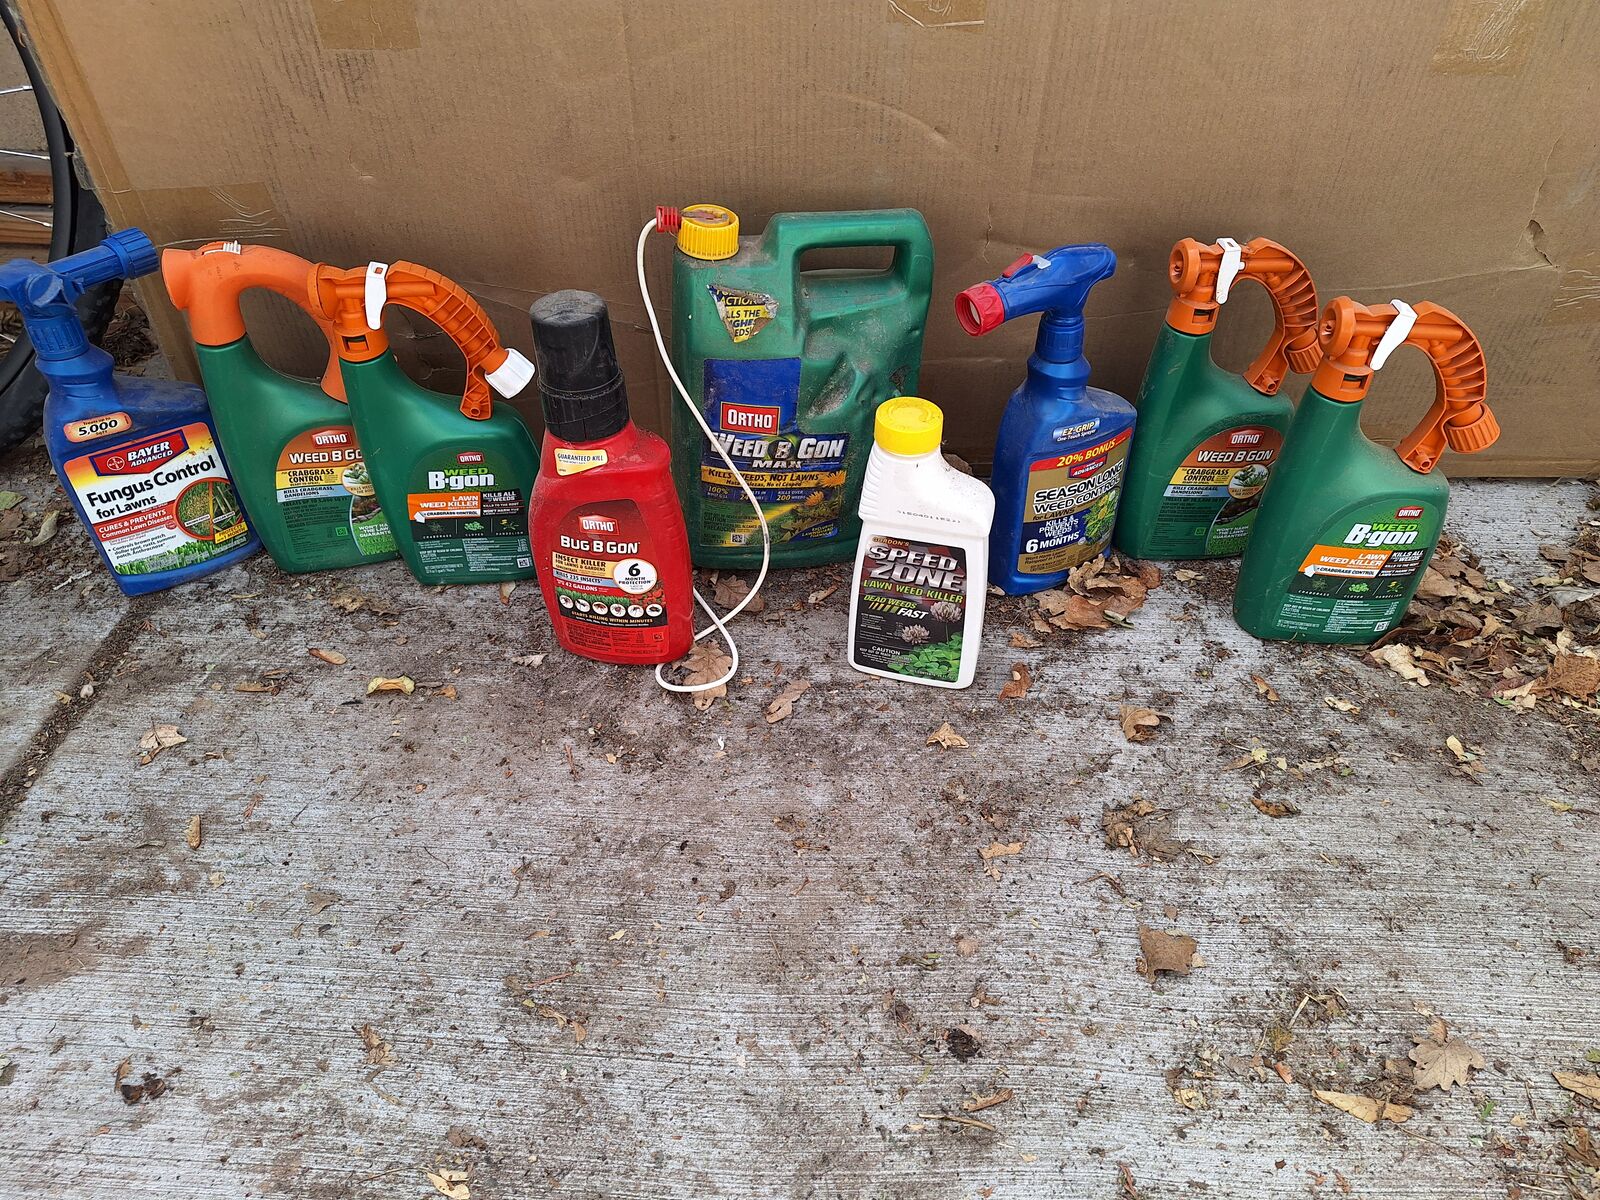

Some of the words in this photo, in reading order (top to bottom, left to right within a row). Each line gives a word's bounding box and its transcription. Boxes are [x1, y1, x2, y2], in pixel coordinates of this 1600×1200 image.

[744, 309, 760, 318] THE
[728, 409, 772, 429] ORTHO
[79, 420, 118, 436] 5,000
[315, 434, 346, 445] ORTHO
[711, 432, 768, 458] WEED
[775, 442, 792, 459] B
[798, 438, 845, 459] GON
[1231, 434, 1260, 444] ORTHO
[128, 442, 170, 462] BAYER
[289, 452, 329, 464] WEED
[332, 450, 342, 461] B
[558, 453, 591, 461] GUARANTEED
[1057, 454, 1084, 467] 20%
[1085, 439, 1116, 460] BONUS
[1198, 450, 1233, 462] WEED
[1235, 451, 1246, 462] B
[1247, 450, 1273, 461] GON
[130, 450, 173, 468] ADVANCED
[752, 460, 802, 469] MAX
[288, 468, 334, 477] CRABGRASS
[444, 468, 488, 476] WEED
[708, 468, 733, 480] KILLS
[770, 474, 787, 482] NOT
[86, 478, 154, 507] Fungus
[154, 455, 216, 487] Control
[289, 475, 323, 484] CONTROL
[1034, 479, 1097, 503] SEASON
[1097, 460, 1124, 486] LONG
[708, 485, 728, 495] 100%
[1033, 498, 1075, 514] WEED
[1075, 478, 1120, 504] CONTROL
[96, 508, 115, 519] for
[116, 496, 157, 513] Lawns
[1044, 508, 1075, 520] LAWNS
[99, 522, 123, 533] CURES
[130, 509, 166, 524] PREVENTS
[101, 528, 130, 538] Common
[130, 522, 147, 531] Lawn
[147, 515, 173, 526] Diseases
[582, 520, 614, 532] ORTHO
[1039, 518, 1078, 534] PREVENTS
[1046, 516, 1067, 526] KILLS
[1372, 523, 1418, 531] WEED
[1045, 526, 1072, 538] WEEDS
[561, 535, 590, 551] BUG
[593, 540, 604, 553] B
[606, 542, 638, 554] GON
[872, 536, 910, 546] GORDON'S
[1026, 539, 1039, 553] 6
[1040, 531, 1080, 549] MONTHS
[556, 554, 579, 564] INSECT
[580, 558, 606, 567] KILLER
[867, 546, 958, 571] SPEED
[628, 563, 640, 576] 6
[870, 560, 965, 592] ZONE
[573, 583, 598, 592] GALLONS
[863, 579, 893, 590] LAWN
[896, 584, 923, 596] WEED
[926, 589, 964, 603] KILLER
[863, 595, 887, 603] DEAD
[888, 598, 918, 609] WEEDS
[589, 613, 608, 621] KILLING
[897, 608, 929, 619] FAST
[872, 646, 901, 656] CAUTION
